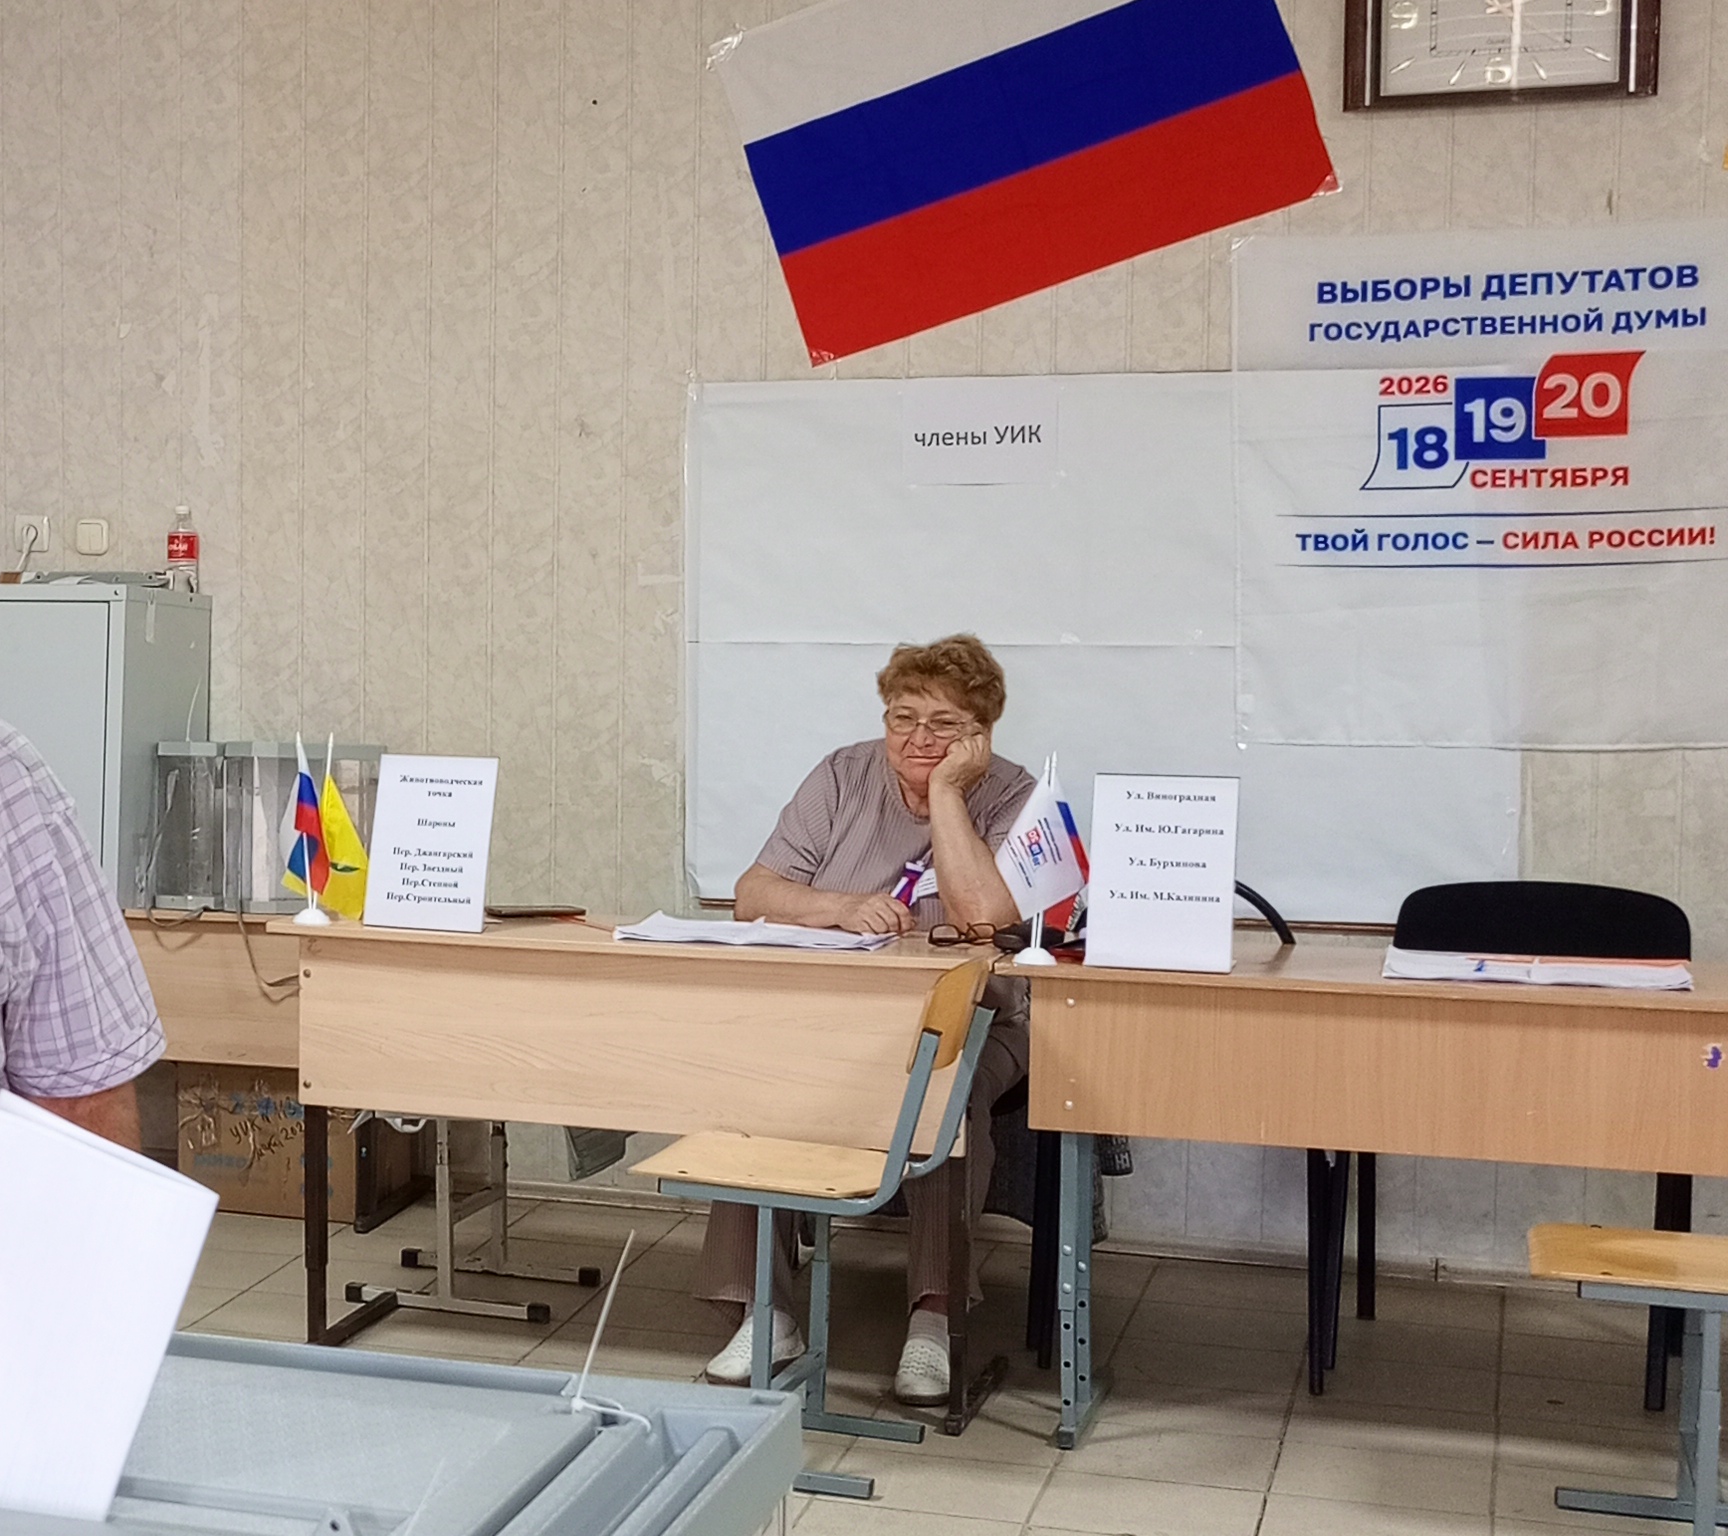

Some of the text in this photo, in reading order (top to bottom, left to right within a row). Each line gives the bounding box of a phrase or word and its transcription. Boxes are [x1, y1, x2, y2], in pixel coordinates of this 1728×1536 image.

[1316, 264, 1700, 305] ВЫБОРЫ ДЕПУТАТОВ
[1308, 307, 1707, 343] ГОСУДАРСТВЕННОЙ ДУМЫ
[1379, 375, 1449, 397] 2026
[1387, 372, 1623, 471] 18 19 20
[914, 424, 1043, 449] члены УИК
[1468, 466, 1630, 489] СЕНТЯБРЯ
[1296, 528, 1369, 552] ТВОЙ
[1376, 531, 1470, 552] ГОЛОС
[1502, 530, 1579, 551] СИЛА
[1588, 526, 1716, 550] РОССИИ!
[427, 790, 453, 798] точка
[1126, 790, 1216, 803] Ул. Виноградная
[1115, 823, 1224, 837] Ул. Им. Ю.Гагарина
[393, 846, 412, 858] Пер.
[400, 862, 419, 873] Пер.
[1128, 856, 1146, 867] Ул.
[1109, 889, 1221, 904] Ул. Им. М.Калинина
